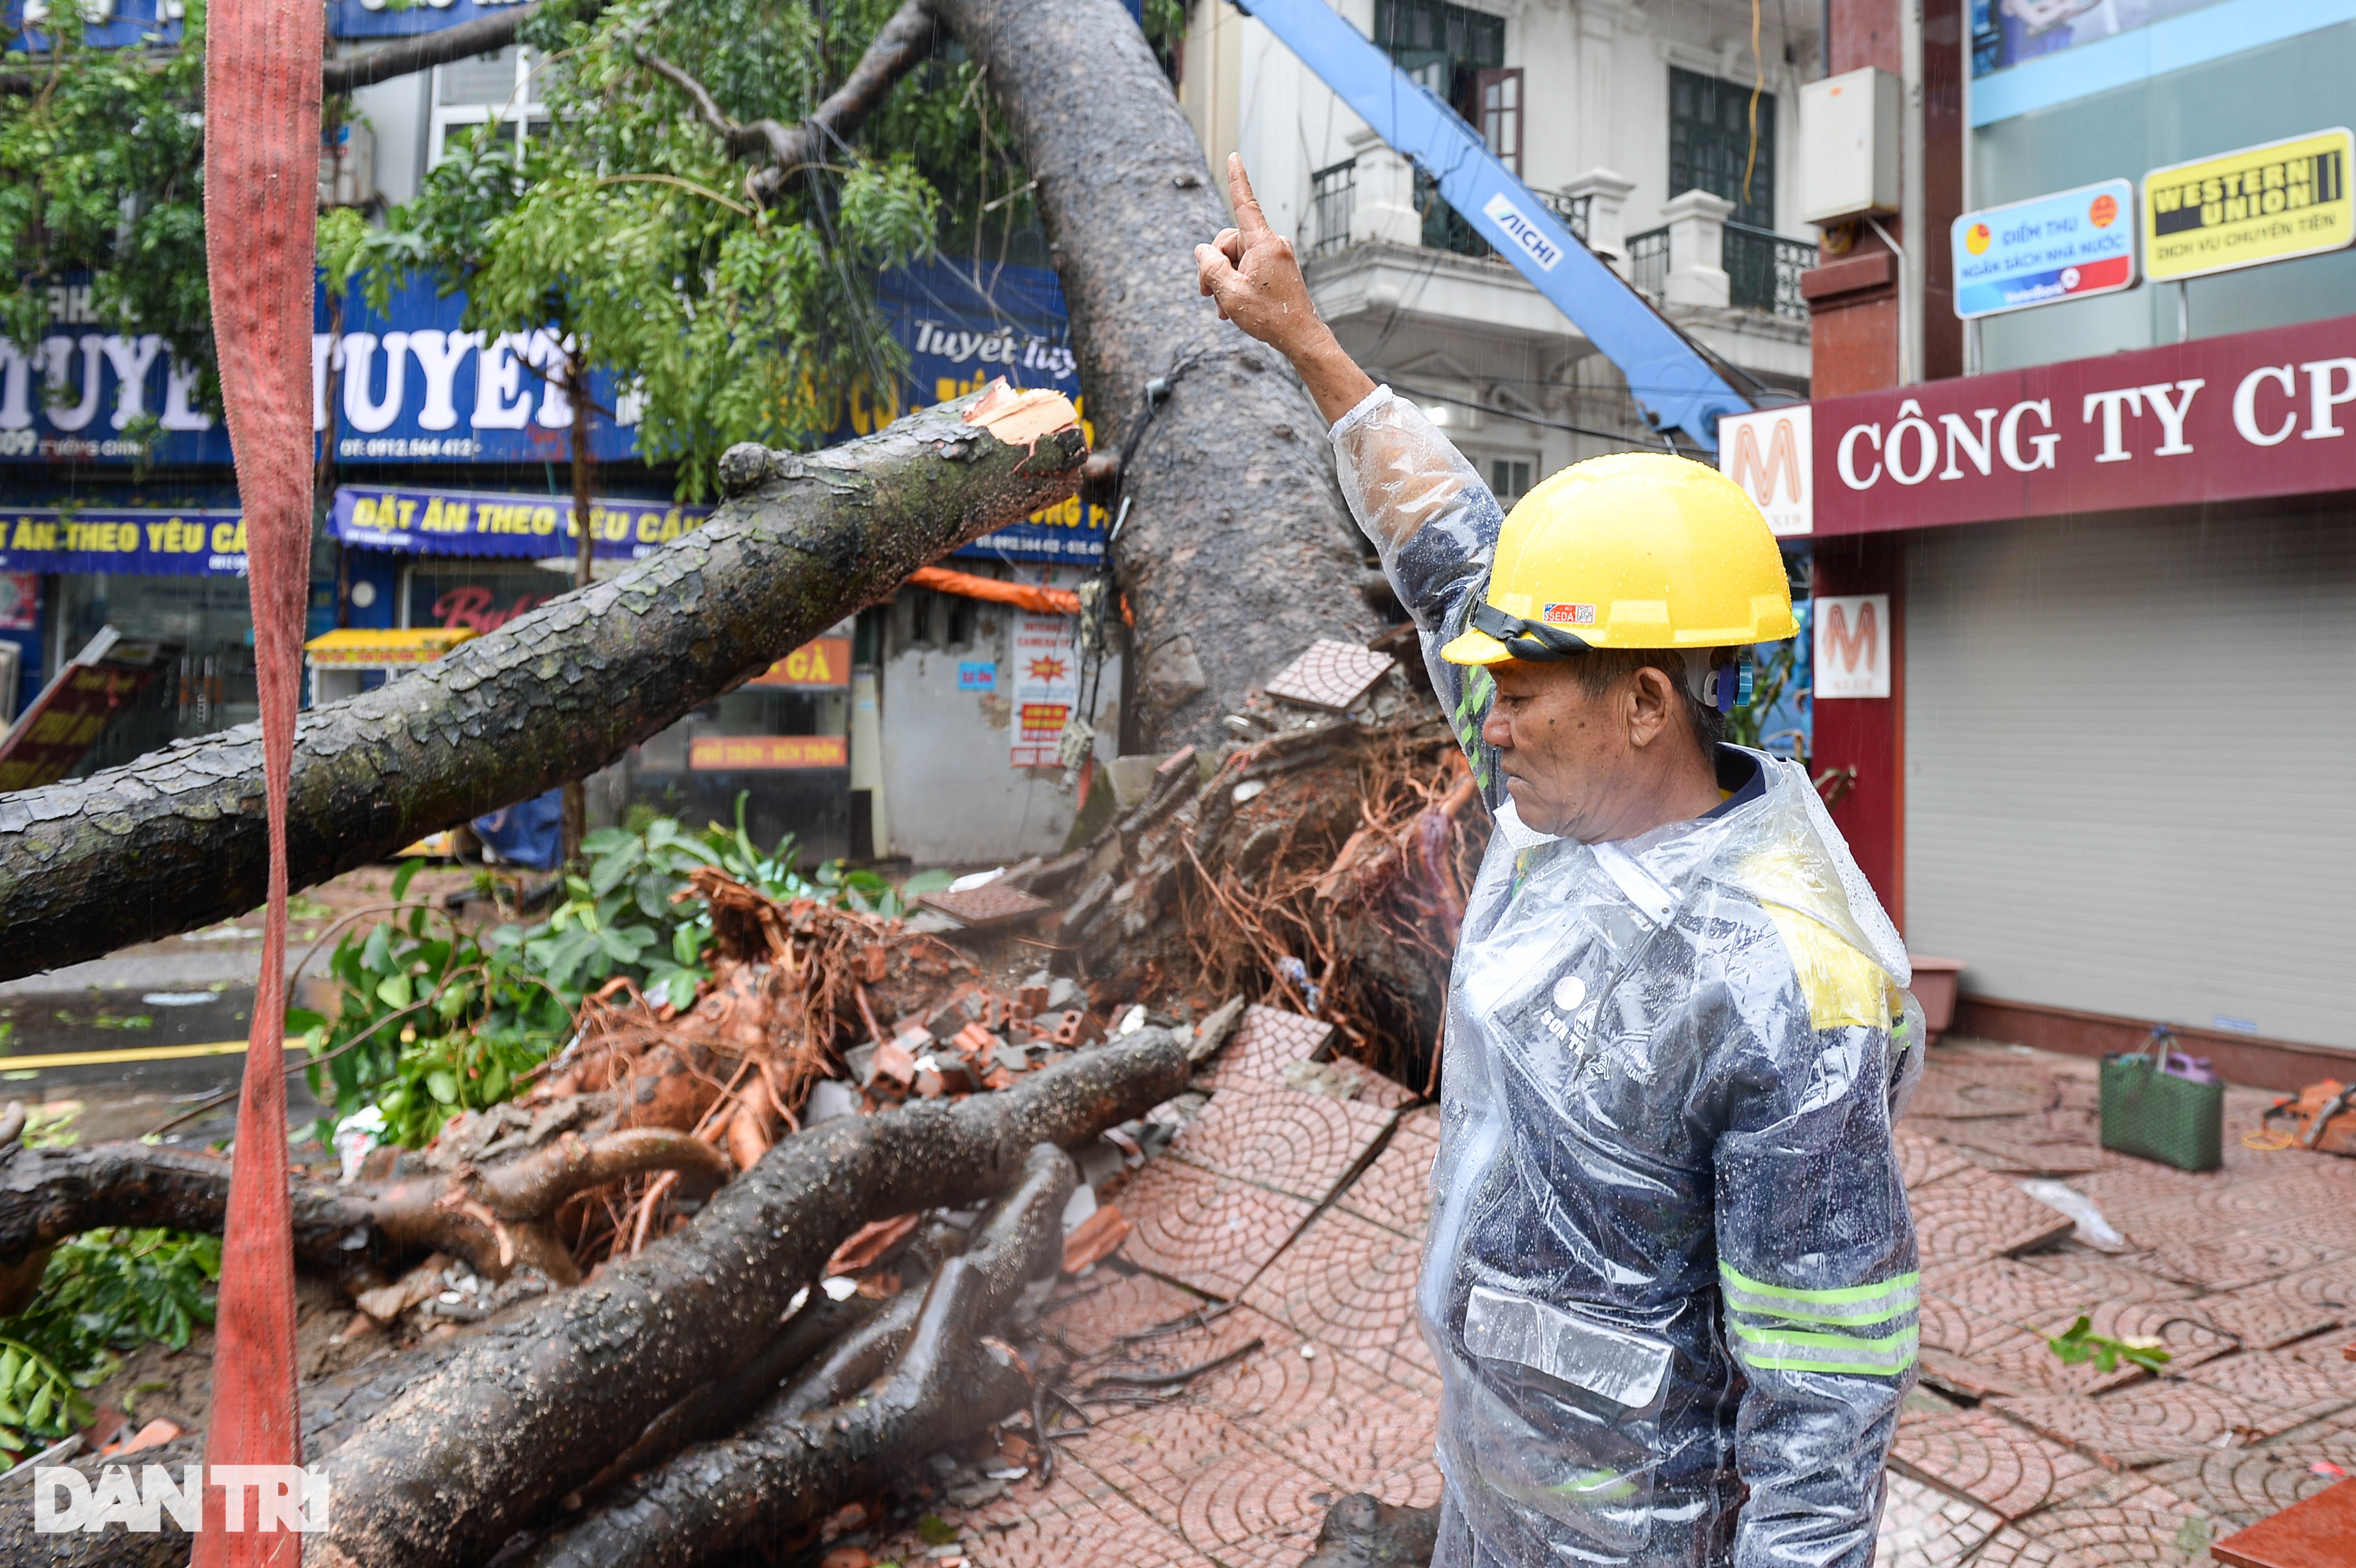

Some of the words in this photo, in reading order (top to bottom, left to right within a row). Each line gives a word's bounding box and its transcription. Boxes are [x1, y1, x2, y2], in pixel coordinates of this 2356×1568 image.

[2155, 158, 2310, 214] WESTERN
[2201, 183, 2311, 227] UNION
[1501, 214, 1555, 263] AICHI
[915, 319, 1018, 364] Tuyết
[1837, 398, 2062, 491] CÔNG
[2082, 378, 2206, 464] TY
[2232, 356, 2356, 448] CP
[66, 521, 140, 552] THEO
[145, 517, 206, 553] YÊU
[352, 493, 419, 534] ĐẶT
[420, 495, 471, 533] ĂN
[476, 502, 557, 535] THEO
[786, 645, 832, 682] GÀ
